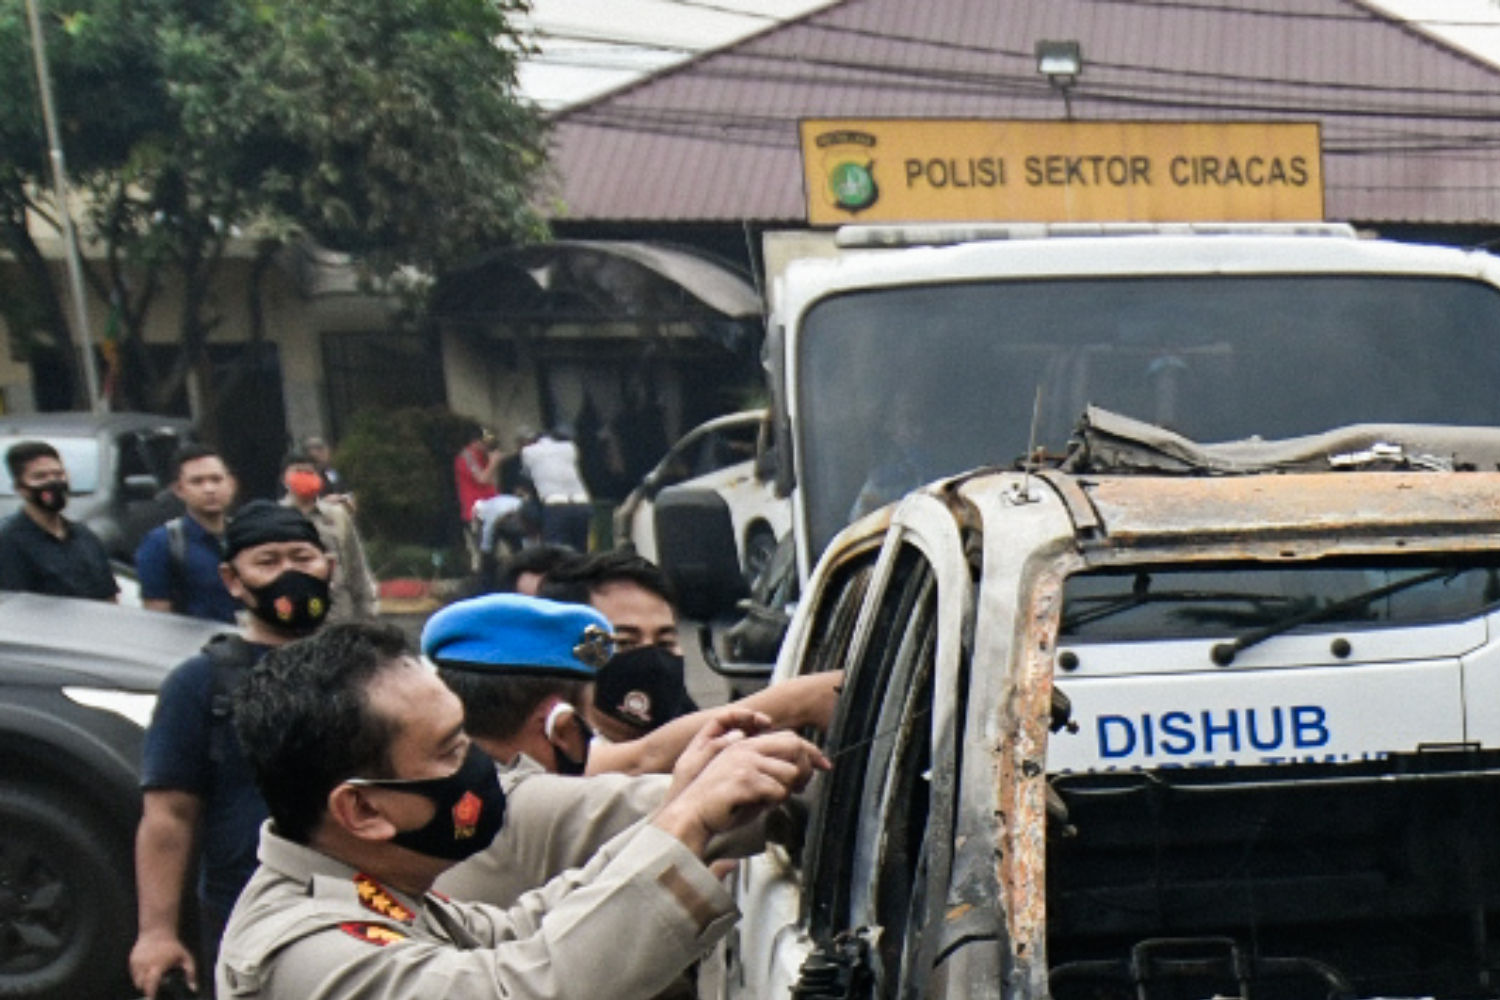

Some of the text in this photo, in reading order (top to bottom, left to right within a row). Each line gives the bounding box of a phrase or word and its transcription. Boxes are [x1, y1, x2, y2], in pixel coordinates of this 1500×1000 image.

[904, 155, 1309, 188] POLISI SEKTOR CIRACAS
[1096, 705, 1330, 759] DISHUB
